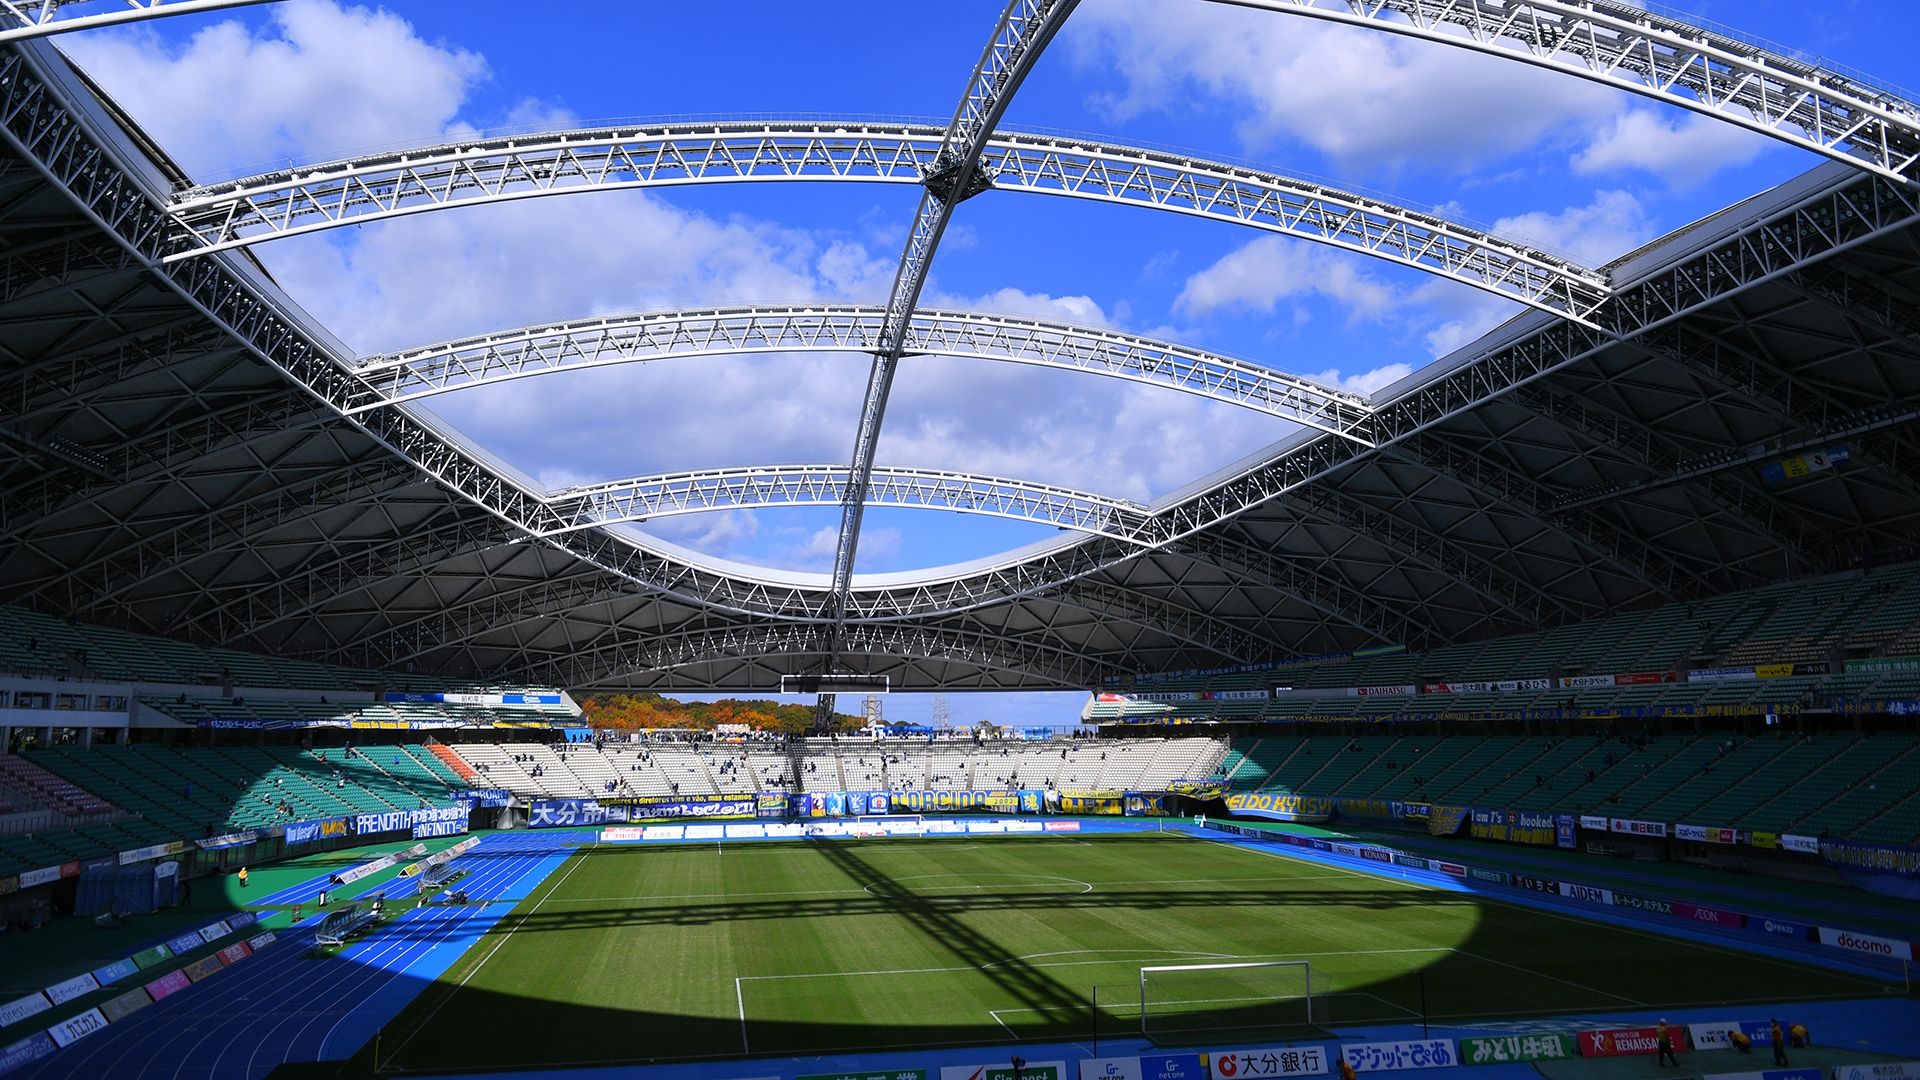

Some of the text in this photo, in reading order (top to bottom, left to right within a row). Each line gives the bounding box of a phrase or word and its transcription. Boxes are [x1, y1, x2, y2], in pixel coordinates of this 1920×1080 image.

[1368, 687, 1406, 696] DAIHATSU
[892, 791, 987, 811] TORCIDA
[1476, 812, 1489, 824] am
[1520, 813, 1555, 829] hooked.
[1569, 886, 1603, 903] AIDEM
[1837, 932, 1892, 955] docomo
[1241, 1050, 1319, 1075] 大分銀行
